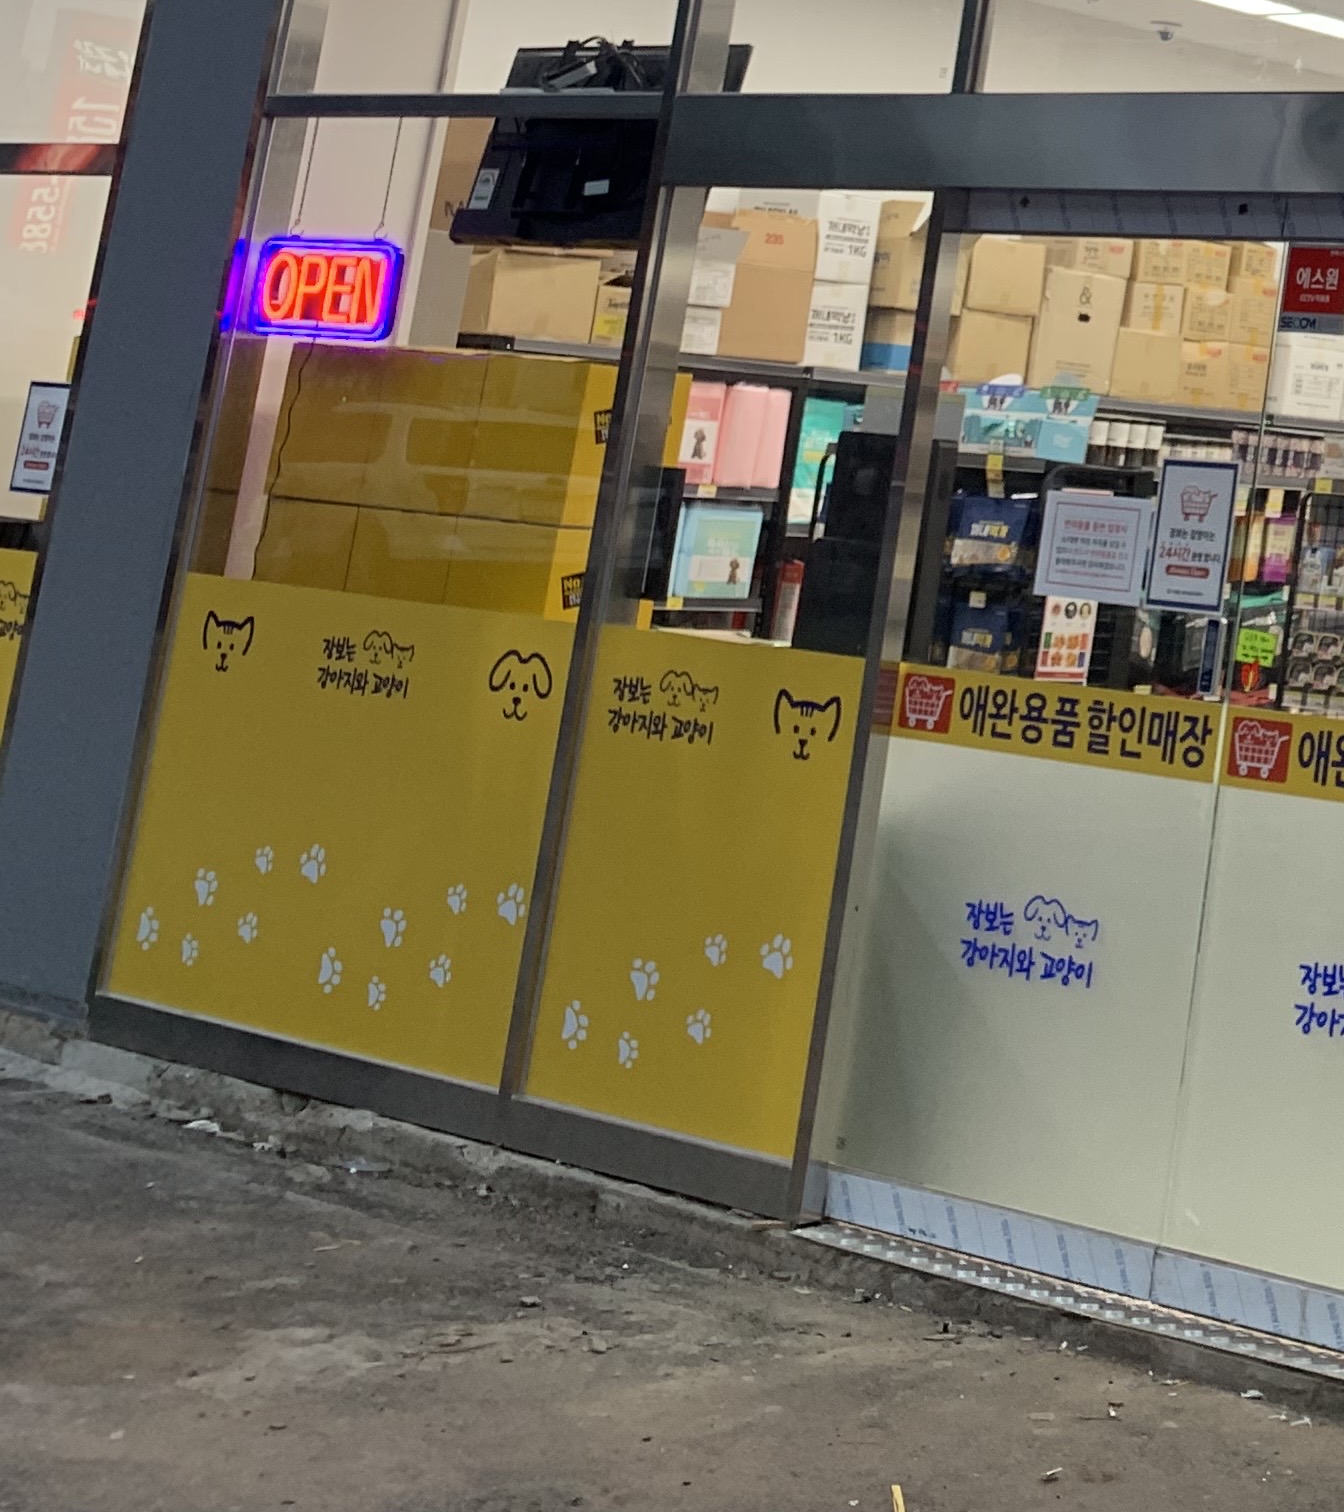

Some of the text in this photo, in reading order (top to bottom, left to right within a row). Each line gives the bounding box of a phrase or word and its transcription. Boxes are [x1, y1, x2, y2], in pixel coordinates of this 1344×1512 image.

[262, 250, 388, 325] OPEN
[1295, 267, 1340, 291] 에스원
[322, 636, 357, 663] 장보는
[316, 665, 410, 700] 강아지와 고양이
[612, 675, 653, 704] 장보는
[606, 706, 715, 745] 강아지와 고양이
[958, 683, 1212, 769] 애완용품 할인매장
[965, 899, 1015, 936] 장보는
[960, 937, 1094, 989] 강아지와 고양이
